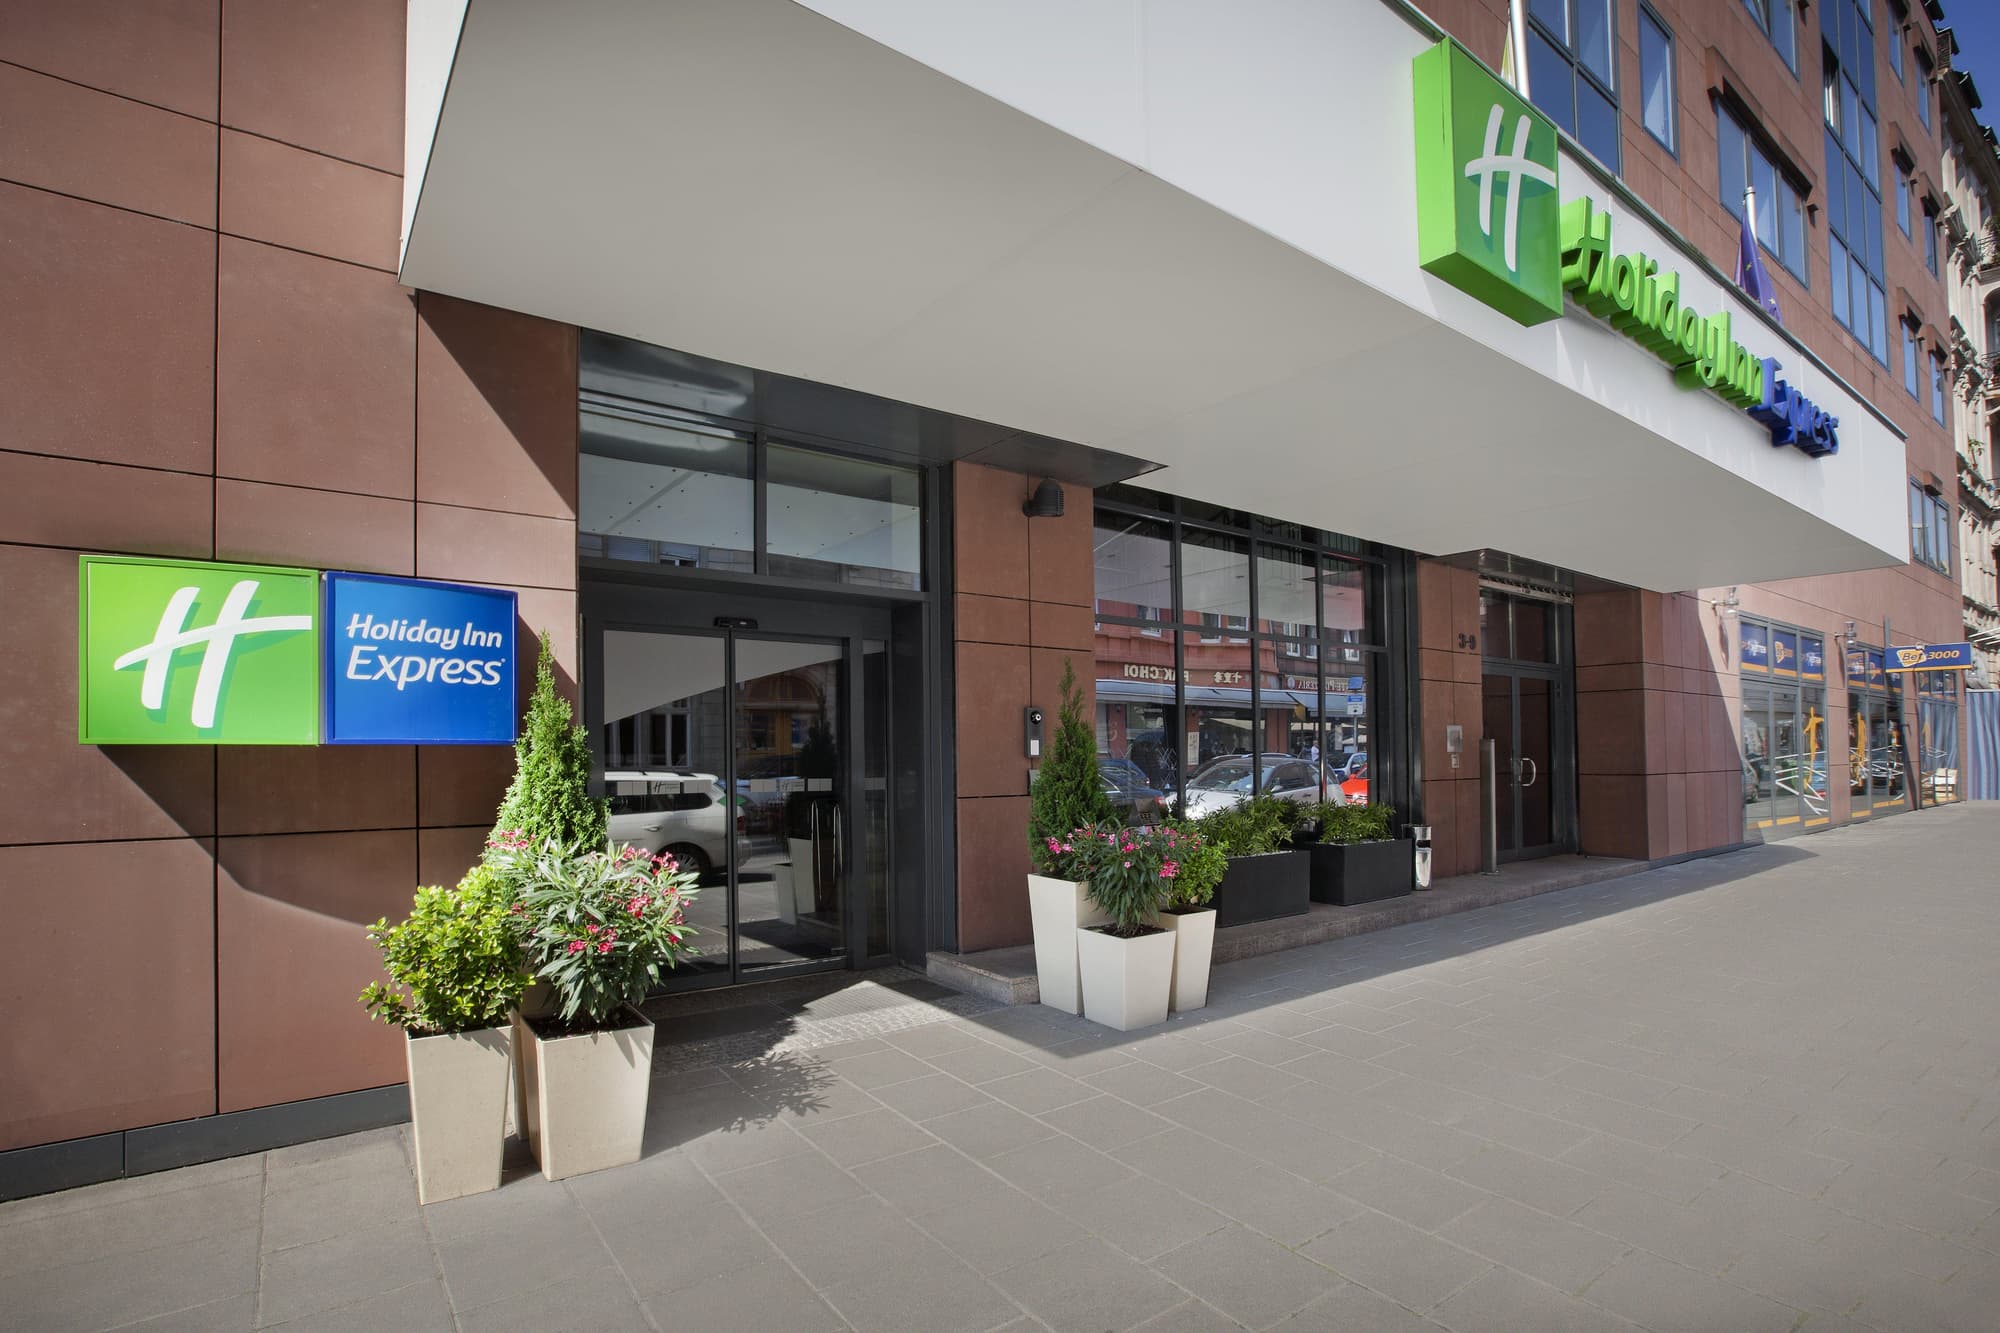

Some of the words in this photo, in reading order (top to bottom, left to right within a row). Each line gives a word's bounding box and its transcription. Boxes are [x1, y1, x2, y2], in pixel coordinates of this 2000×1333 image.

[1561, 195, 1720, 386] Holiday
[1713, 310, 1765, 408] Inn
[346, 613, 461, 650] Holiday
[463, 622, 502, 649] Inn
[346, 645, 502, 690] Express
[1902, 652, 1923, 661] Bet
[1928, 650, 1960, 660] 3000
